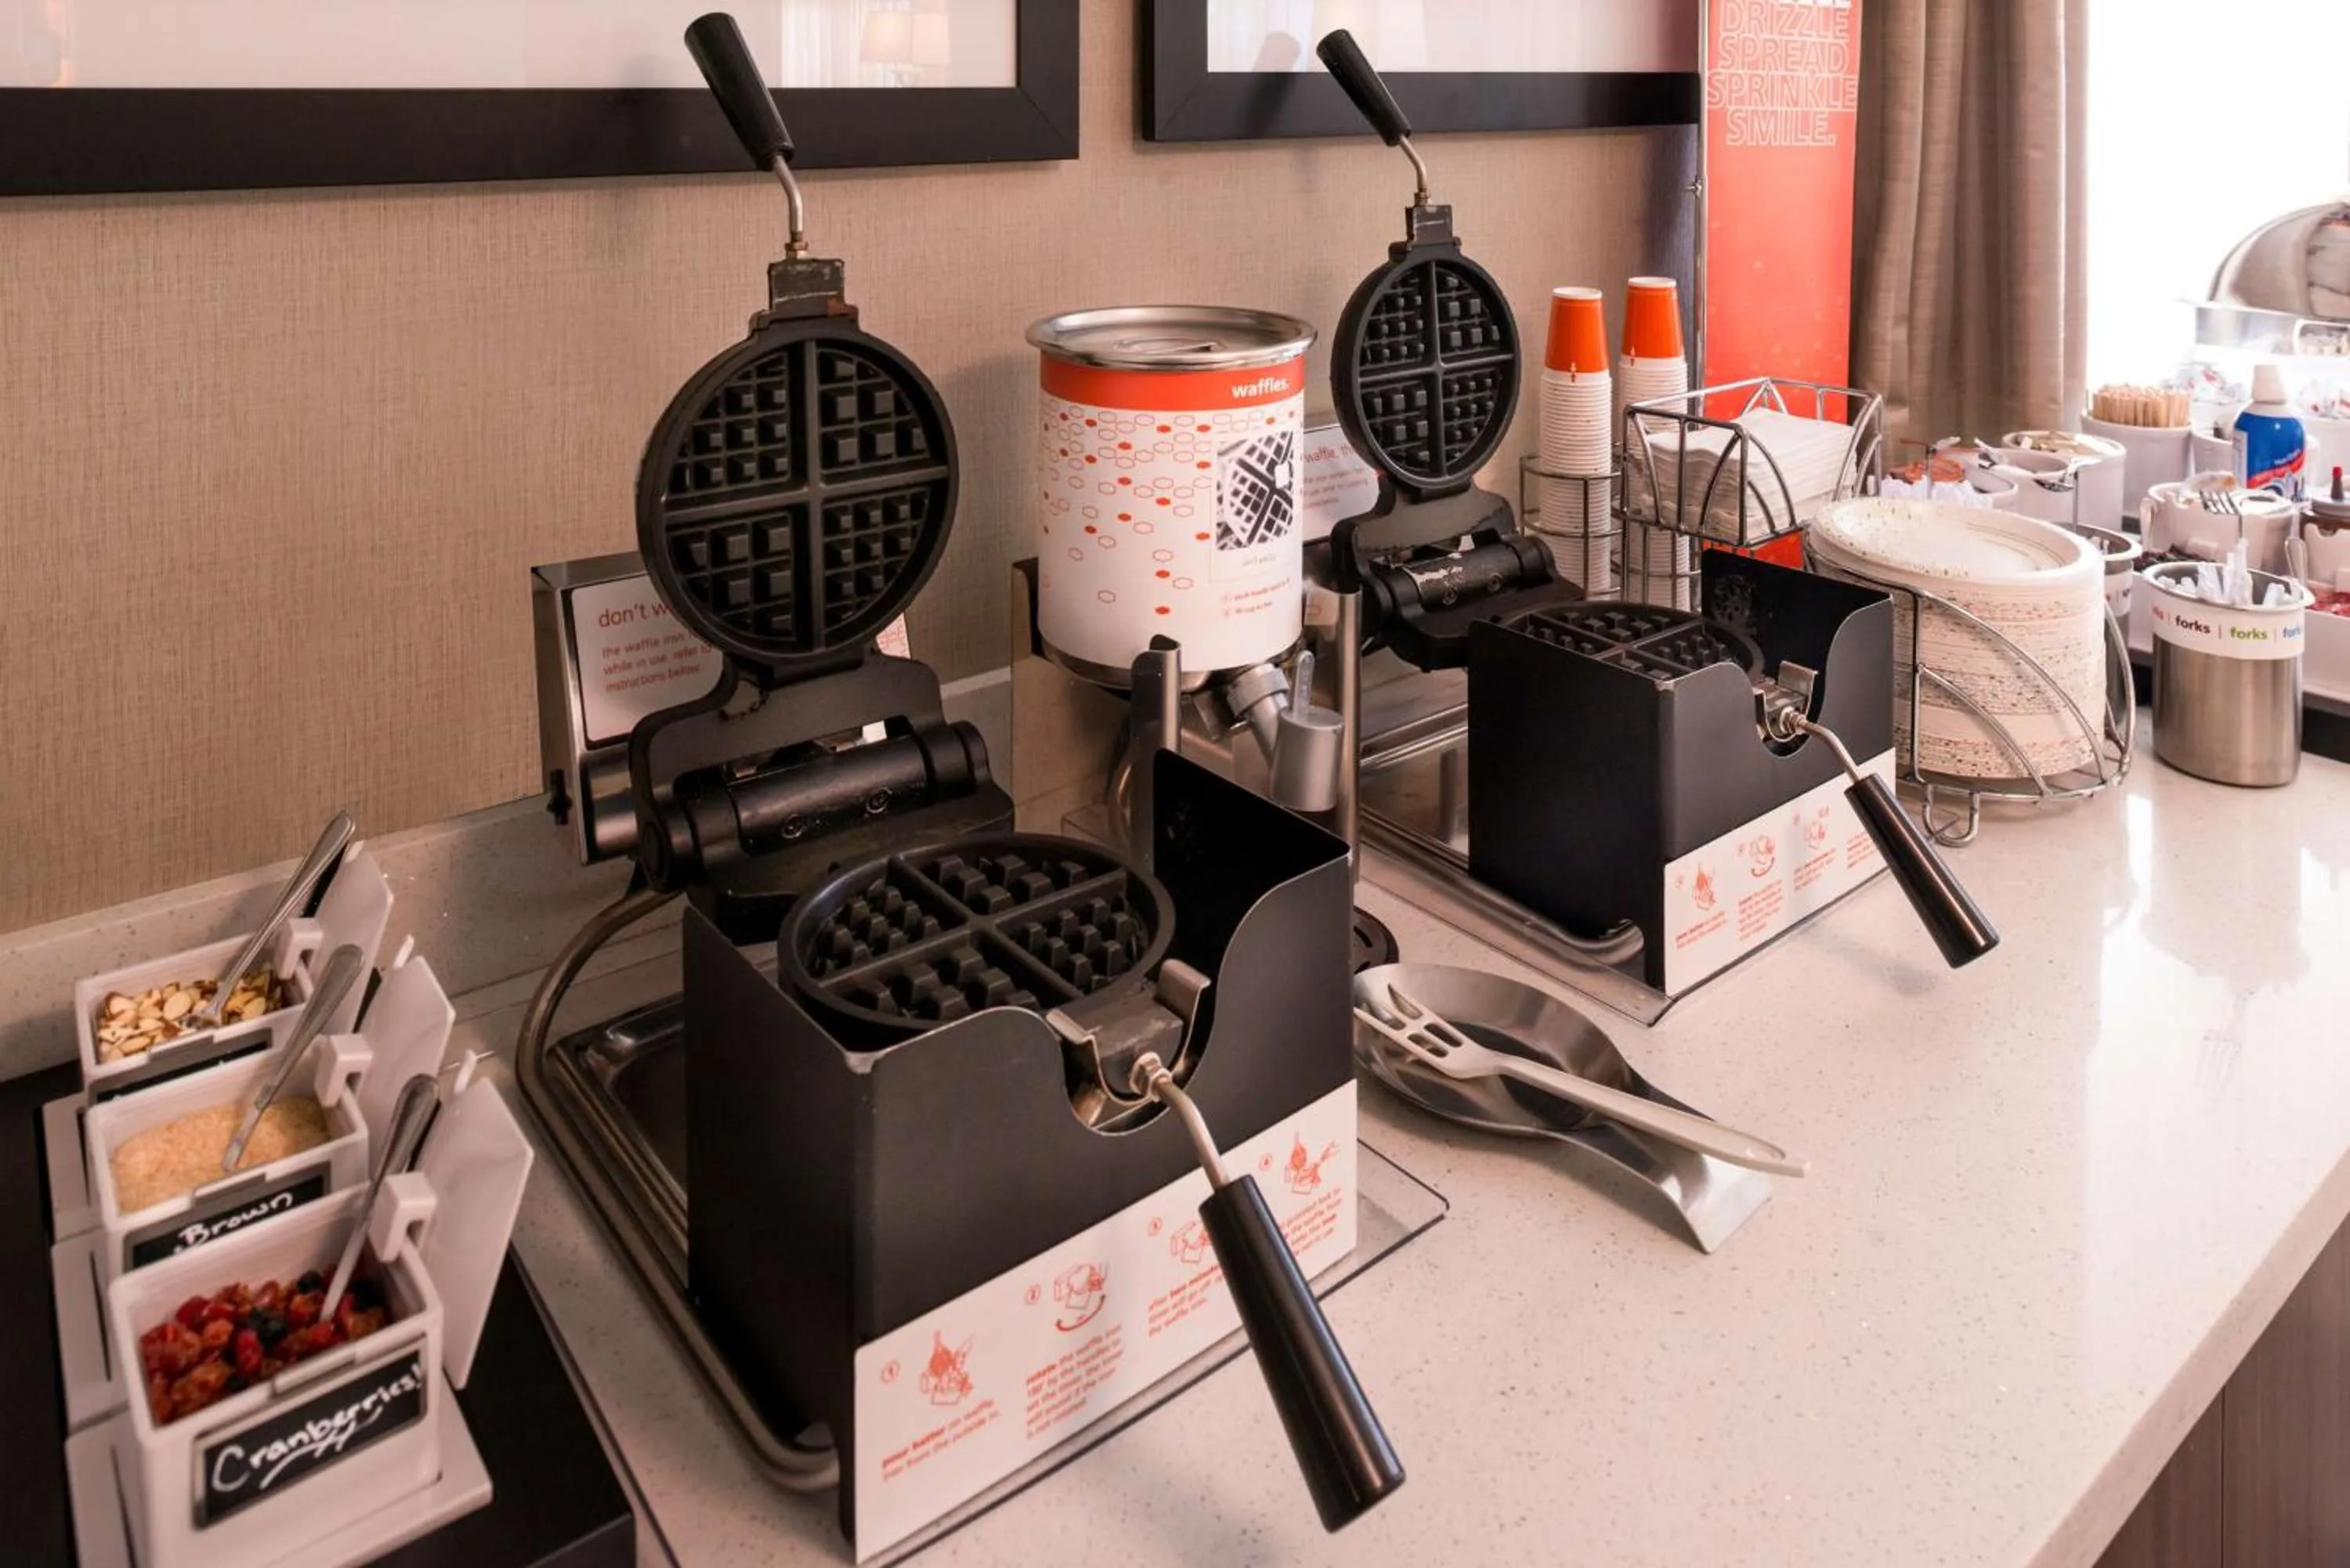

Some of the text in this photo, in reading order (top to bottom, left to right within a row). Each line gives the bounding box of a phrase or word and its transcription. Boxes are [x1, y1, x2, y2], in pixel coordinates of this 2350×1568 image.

[1719, 1, 1850, 42] DRIZZLE
[1718, 34, 1849, 76] SPREAD
[1707, 69, 1857, 112] SPRINKLE
[1726, 108, 1836, 146] SMILE.
[598, 603, 648, 627] don't
[2175, 615, 2211, 634] forks
[2230, 626, 2268, 640] forks
[179, 1192, 294, 1245] Brown
